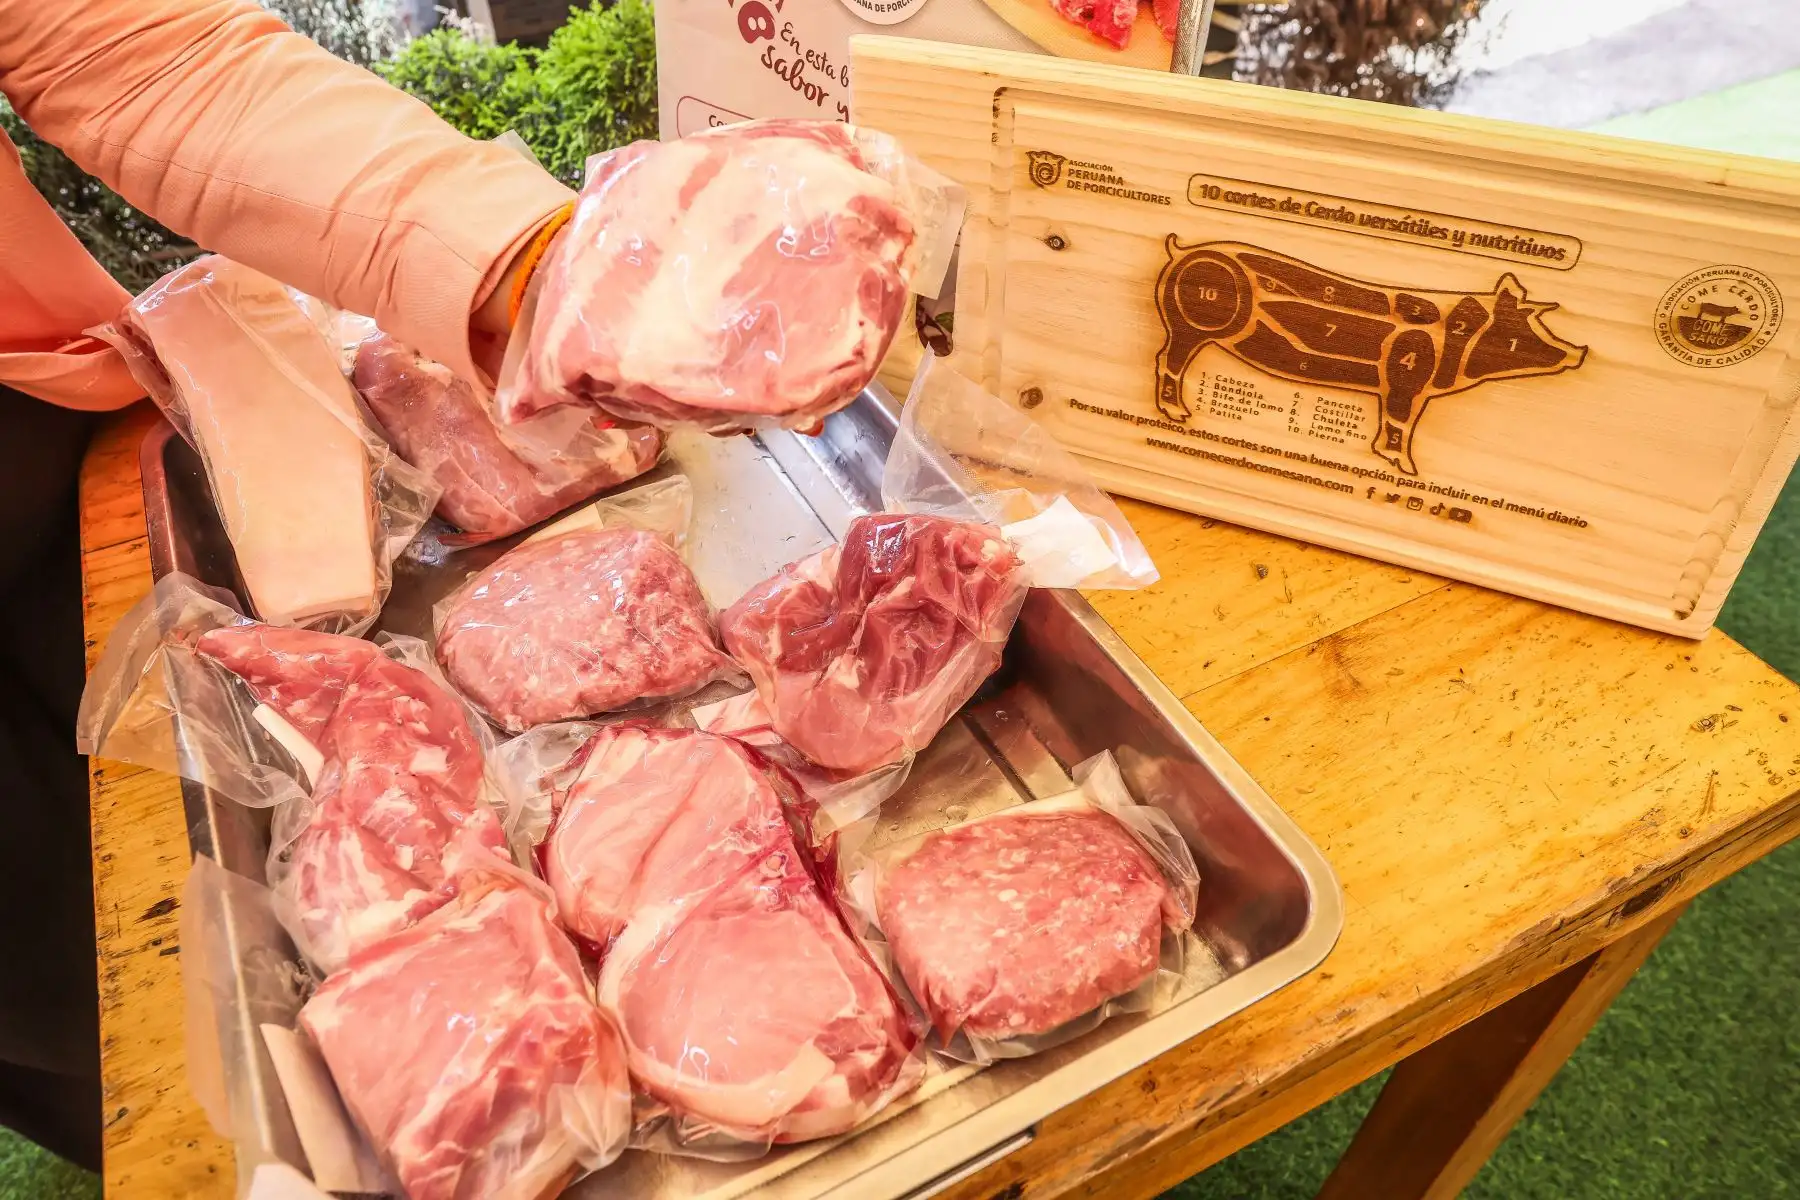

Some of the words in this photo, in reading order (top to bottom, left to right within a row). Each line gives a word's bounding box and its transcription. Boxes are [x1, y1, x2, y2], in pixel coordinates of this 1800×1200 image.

[875, 4, 886, 12] DE
[780, 22, 802, 55] En
[805, 49, 836, 79] esta
[760, 45, 829, 107] sabor
[1068, 159, 1113, 172] ASOCIACIÓN
[1067, 168, 1124, 186] PERUANA
[1067, 179, 1082, 191] DE
[1083, 182, 1171, 206] PORCICULTORES
[1200, 183, 1220, 200] 10
[1223, 189, 1275, 210] cortes
[1279, 196, 1301, 215] de
[1304, 200, 1354, 224] Cerdo
[1359, 212, 1449, 241] versátiles
[1451, 228, 1465, 247] y
[1469, 230, 1566, 261] nutritivos
[1198, 287, 1218, 301] 10
[1266, 279, 1277, 292] 9
[1322, 286, 1335, 303] 8
[1664, 276, 1700, 311] ASOCIACIÓN
[1701, 269, 1741, 279] PERUANA
[1742, 271, 1754, 282] DE
[1752, 275, 1779, 328] PORCICULTORES
[1681, 285, 1718, 311] COME
[1728, 285, 1759, 321] CERDO
[1411, 306, 1421, 316] 3
[1324, 323, 1337, 338] 7
[1452, 321, 1467, 335] 2
[1692, 319, 1729, 337] COME
[1509, 338, 1519, 352] 1
[1658, 321, 1693, 362] GARANTÍA
[1696, 357, 1712, 366] DE
[1716, 337, 1766, 366] CALIDAD
[1688, 332, 1729, 346] SANO
[1299, 362, 1308, 371] 6
[1400, 351, 1417, 371] 4
[1215, 374, 1255, 389] Cabeza
[1164, 385, 1174, 398] 5
[1213, 382, 1264, 400] Bondiola
[1210, 400, 1260, 416] Brazuelo
[1212, 391, 1236, 403] Bife
[1239, 396, 1252, 406] de
[1256, 400, 1284, 413] lomo
[1316, 396, 1363, 413] Panceta
[1209, 407, 1243, 421] Patita
[1312, 413, 1358, 430] Chuleta
[1314, 405, 1366, 422] Costillar
[1307, 429, 1346, 443] Pierna
[1311, 423, 1342, 435] Lomo
[1345, 428, 1367, 441] fino
[1390, 433, 1400, 445] 5
[1069, 398, 1089, 411] Por
[1091, 405, 1104, 416] su
[1106, 408, 1136, 423] valor
[1136, 414, 1188, 436] proteico,
[1189, 427, 1220, 442] estos
[1221, 435, 1259, 450] cortes
[1260, 445, 1282, 457] son
[1284, 450, 1308, 463] una
[1310, 453, 1349, 472] buena
[1351, 463, 1395, 484] opción
[1395, 475, 1427, 491] para
[1428, 481, 1471, 502] incluir
[1471, 494, 1489, 506] en
[1490, 498, 1504, 509] el
[1505, 501, 1545, 519] menú
[1546, 510, 1589, 529] diario
[1146, 436, 1354, 494] www.comecerdocomesano.com
